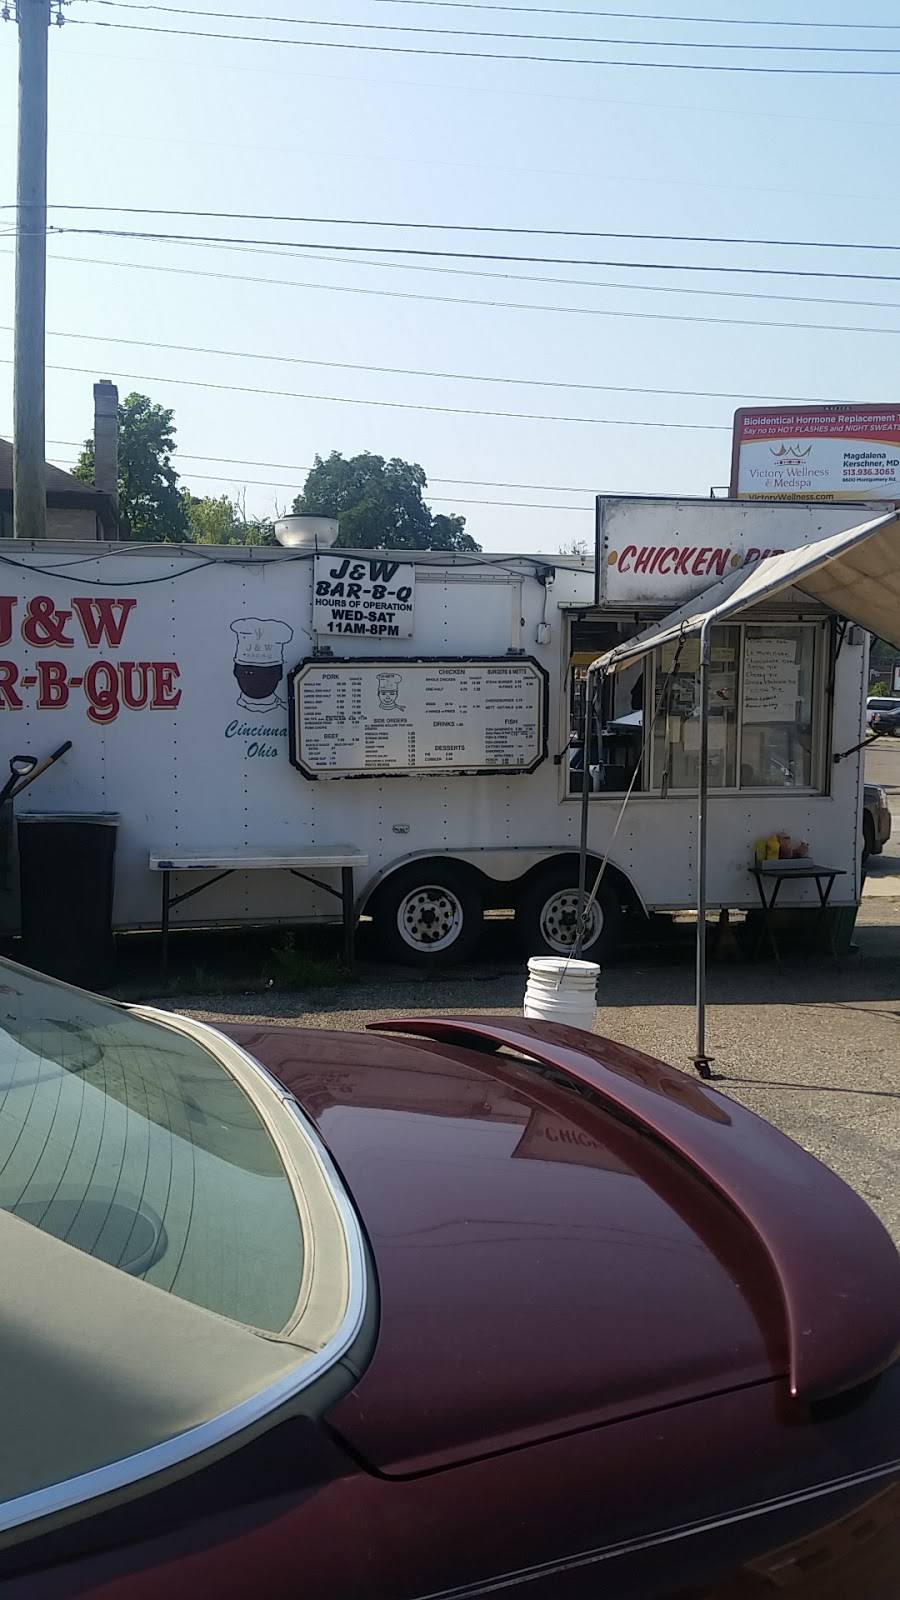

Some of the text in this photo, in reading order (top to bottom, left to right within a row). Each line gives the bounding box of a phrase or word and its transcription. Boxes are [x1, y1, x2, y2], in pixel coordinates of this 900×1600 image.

[797, 416, 836, 424] Hormone
[838, 414, 895, 425] Replacement
[743, 427, 757, 435] Say
[795, 425, 828, 433] FLASHES
[843, 452, 887, 461] Magdalena
[843, 460, 885, 468] Kerschner,
[750, 466, 830, 479] Victory Wellness
[842, 468, 895, 476] 513.936.3065
[774, 479, 812, 490] Medspa
[748, 493, 834, 501] VictoryWellness.com
[617, 545, 732, 577] CHICKEN
[329, 559, 400, 583] J&W
[315, 580, 412, 603] BAR-B-Q
[315, 598, 412, 611] HOURS OF OPERATION
[331, 609, 396, 623] WED-SAT
[327, 622, 399, 636] 11AM-8PM
[247, 742, 279, 758] Ohio
